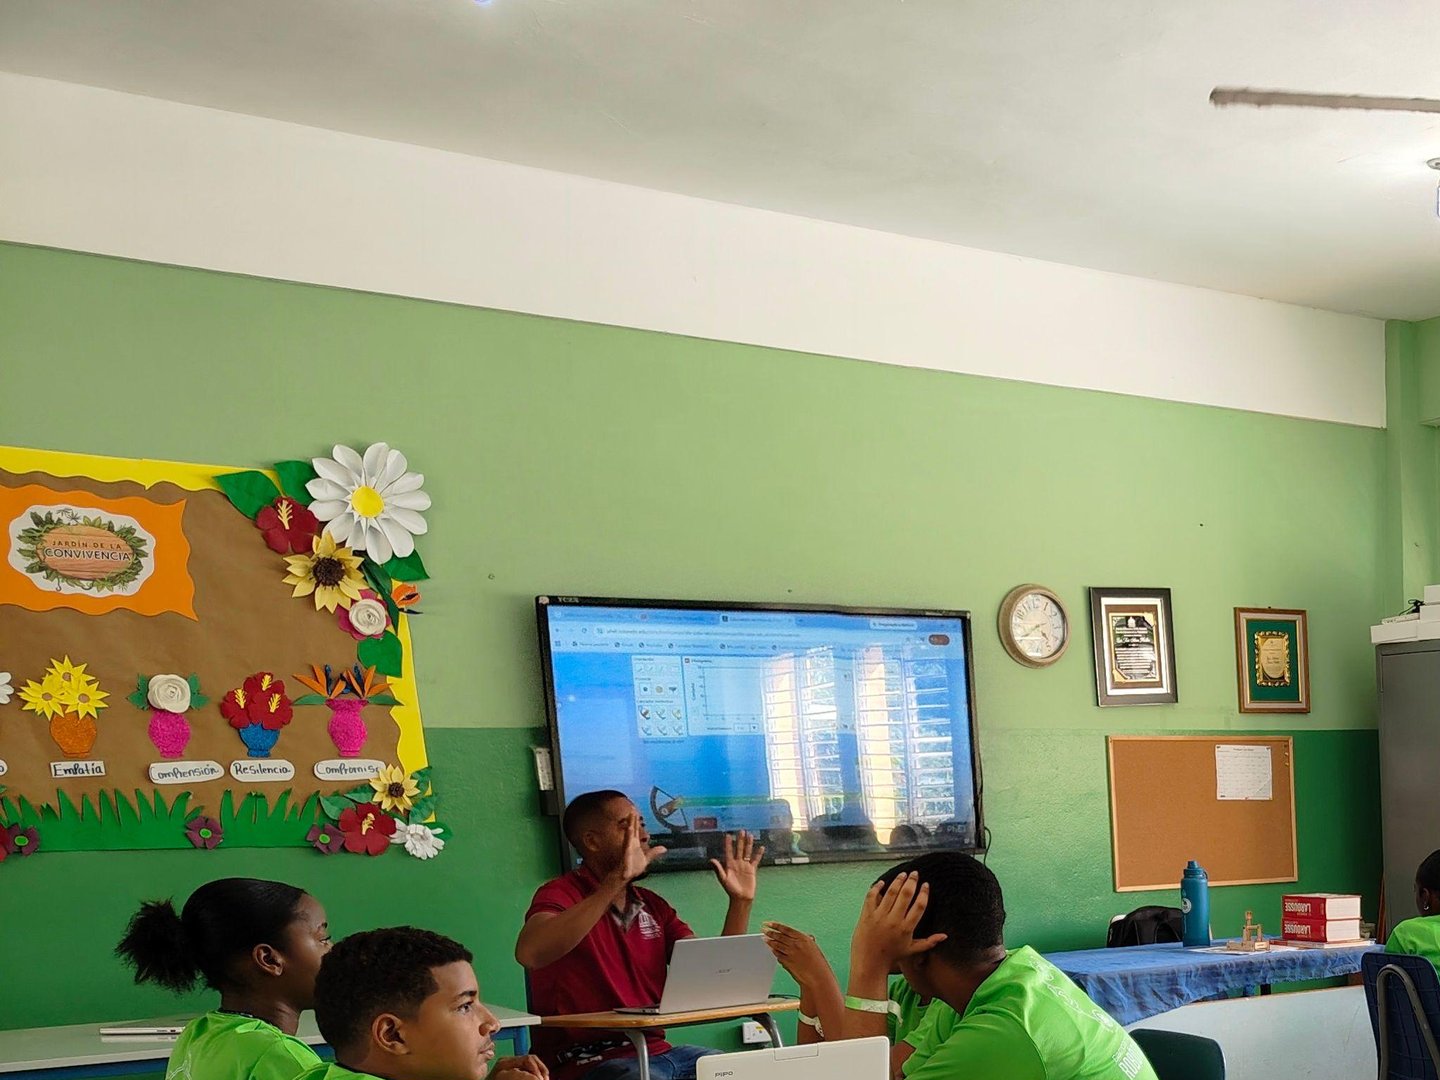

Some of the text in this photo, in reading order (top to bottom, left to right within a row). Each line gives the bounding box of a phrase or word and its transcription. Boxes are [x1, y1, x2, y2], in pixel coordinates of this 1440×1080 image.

[93, 541, 106, 549] DE
[109, 542, 123, 550] LA
[44, 548, 131, 561] CONVIVENCIA
[1285, 902, 1311, 913] LAROUSSE
[1284, 924, 1311, 935] LAROUSSE
